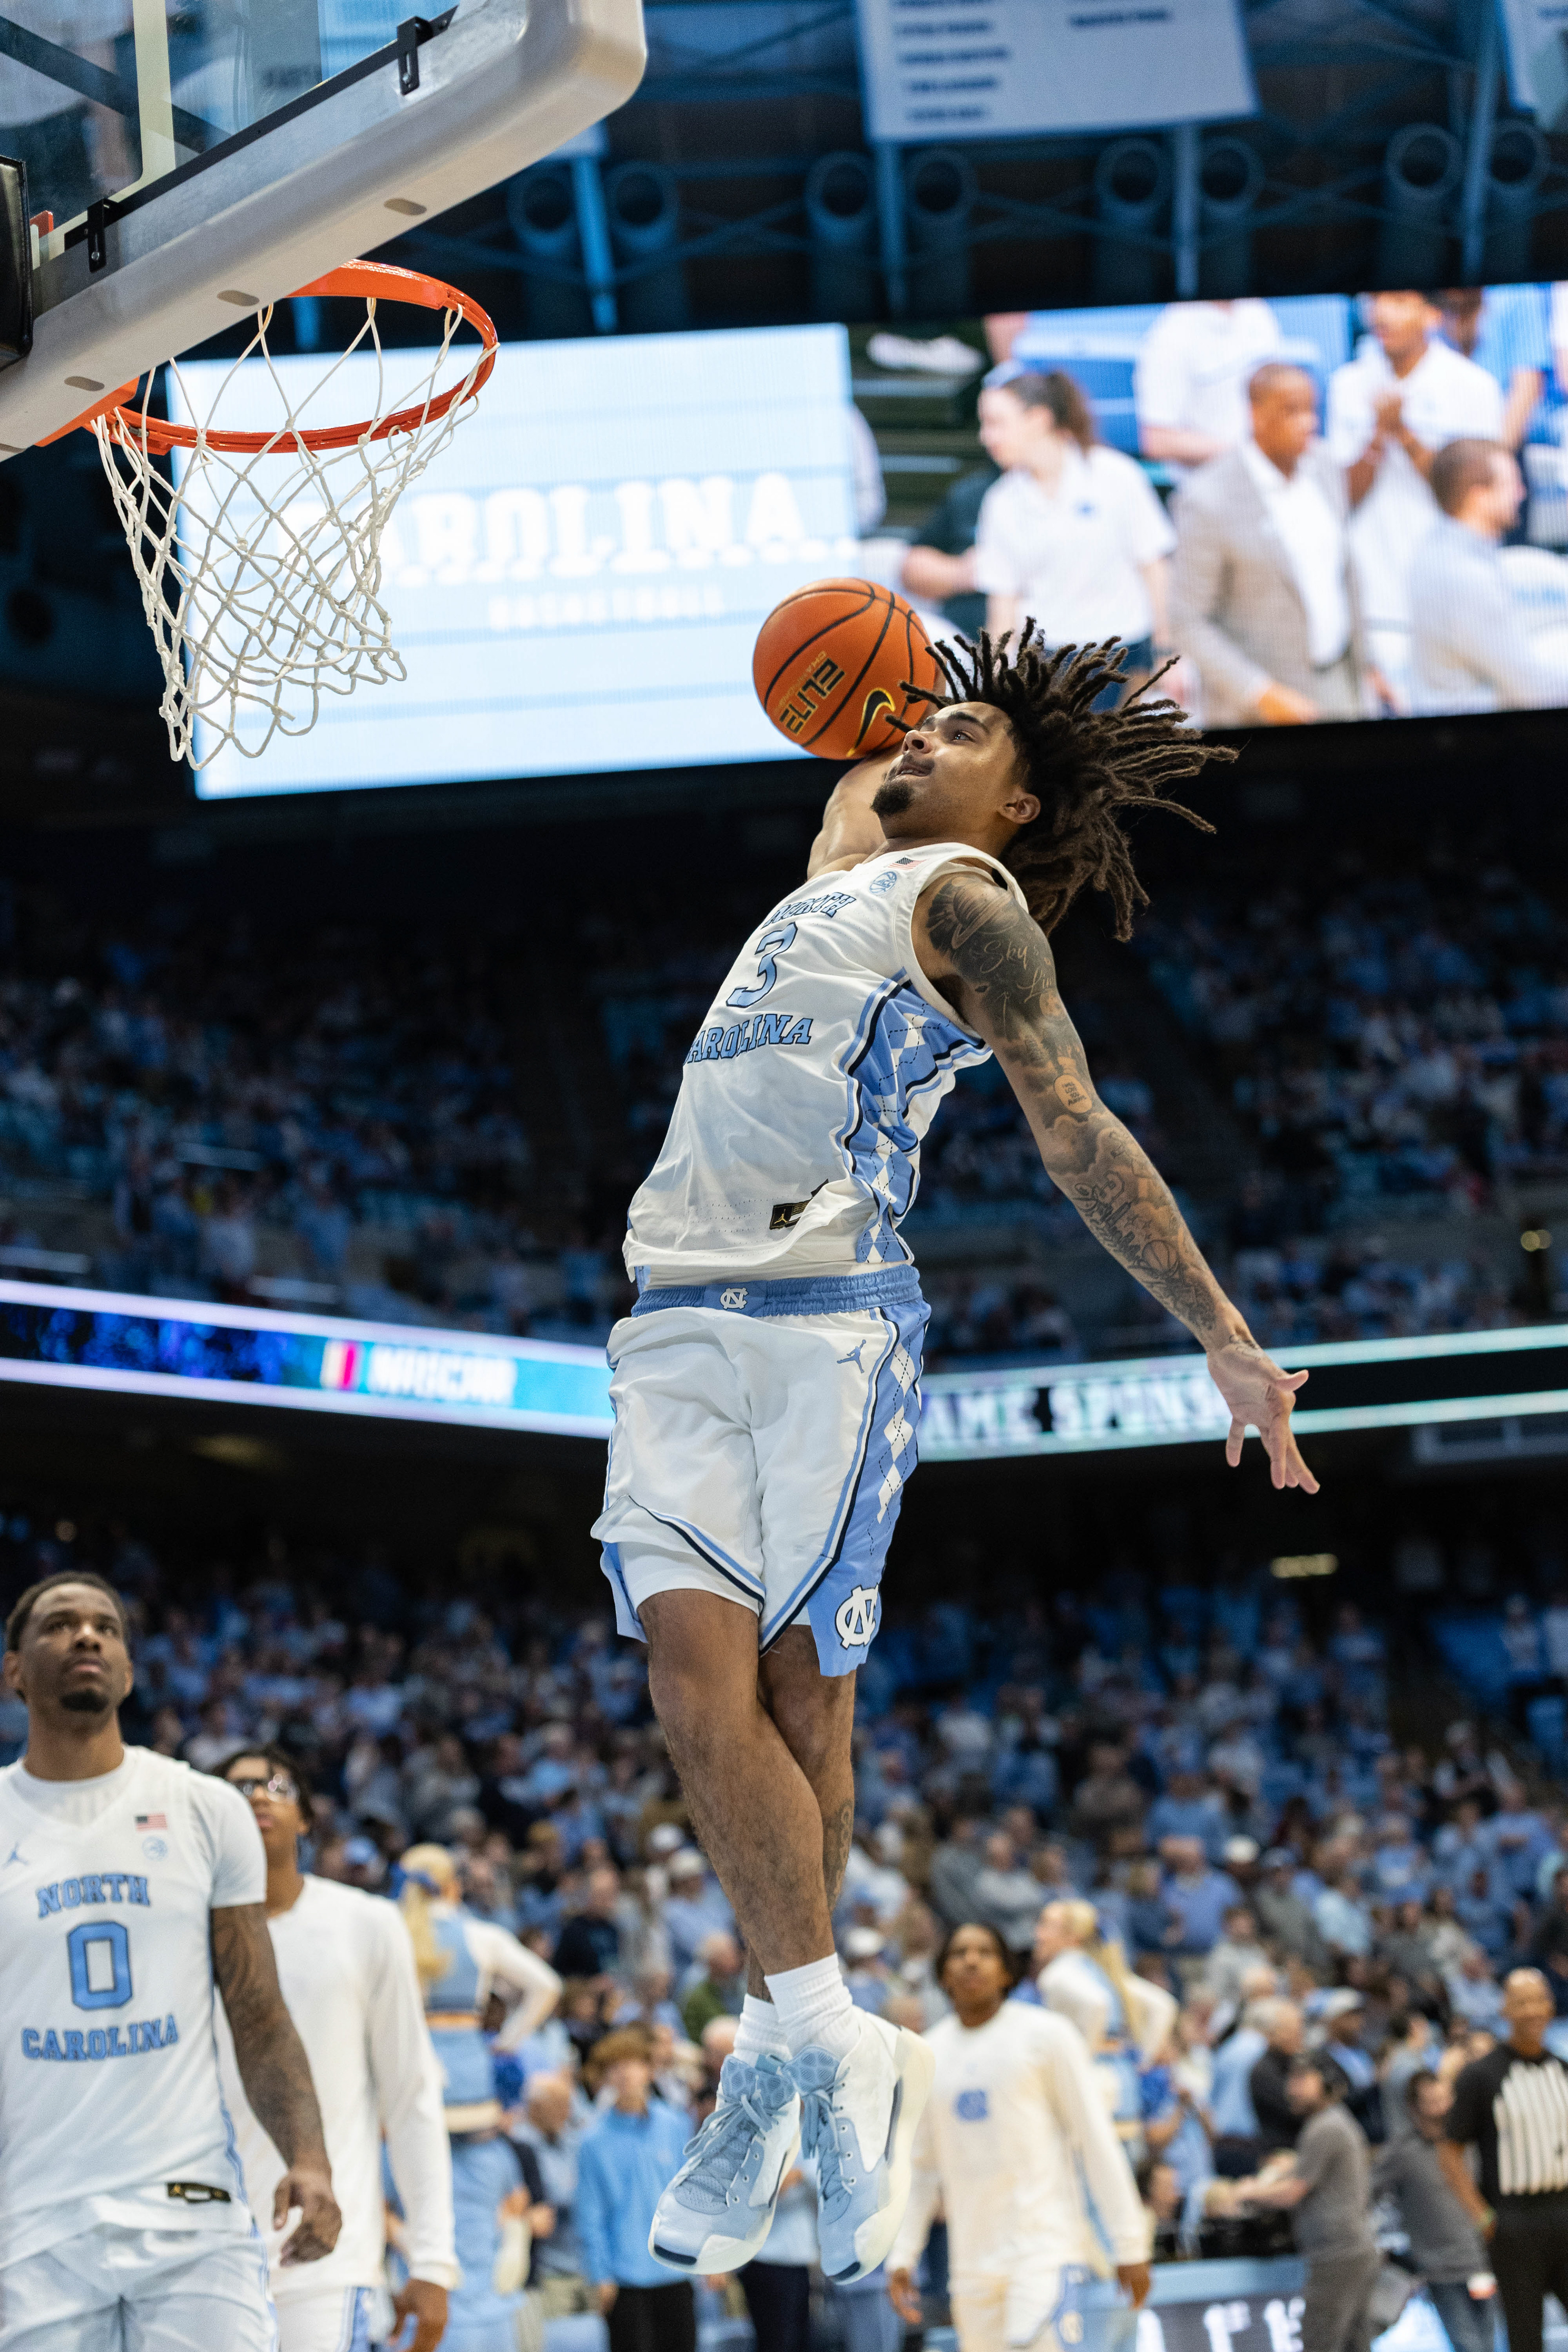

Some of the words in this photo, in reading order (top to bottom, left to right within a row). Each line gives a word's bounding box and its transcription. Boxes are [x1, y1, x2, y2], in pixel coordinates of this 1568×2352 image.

[779, 658, 845, 735] ELITE
[726, 921, 798, 1008] 3
[36, 1873, 152, 1919] NORTH
[67, 1921, 133, 2011] 0
[21, 2013, 180, 2061] CAROLINA
